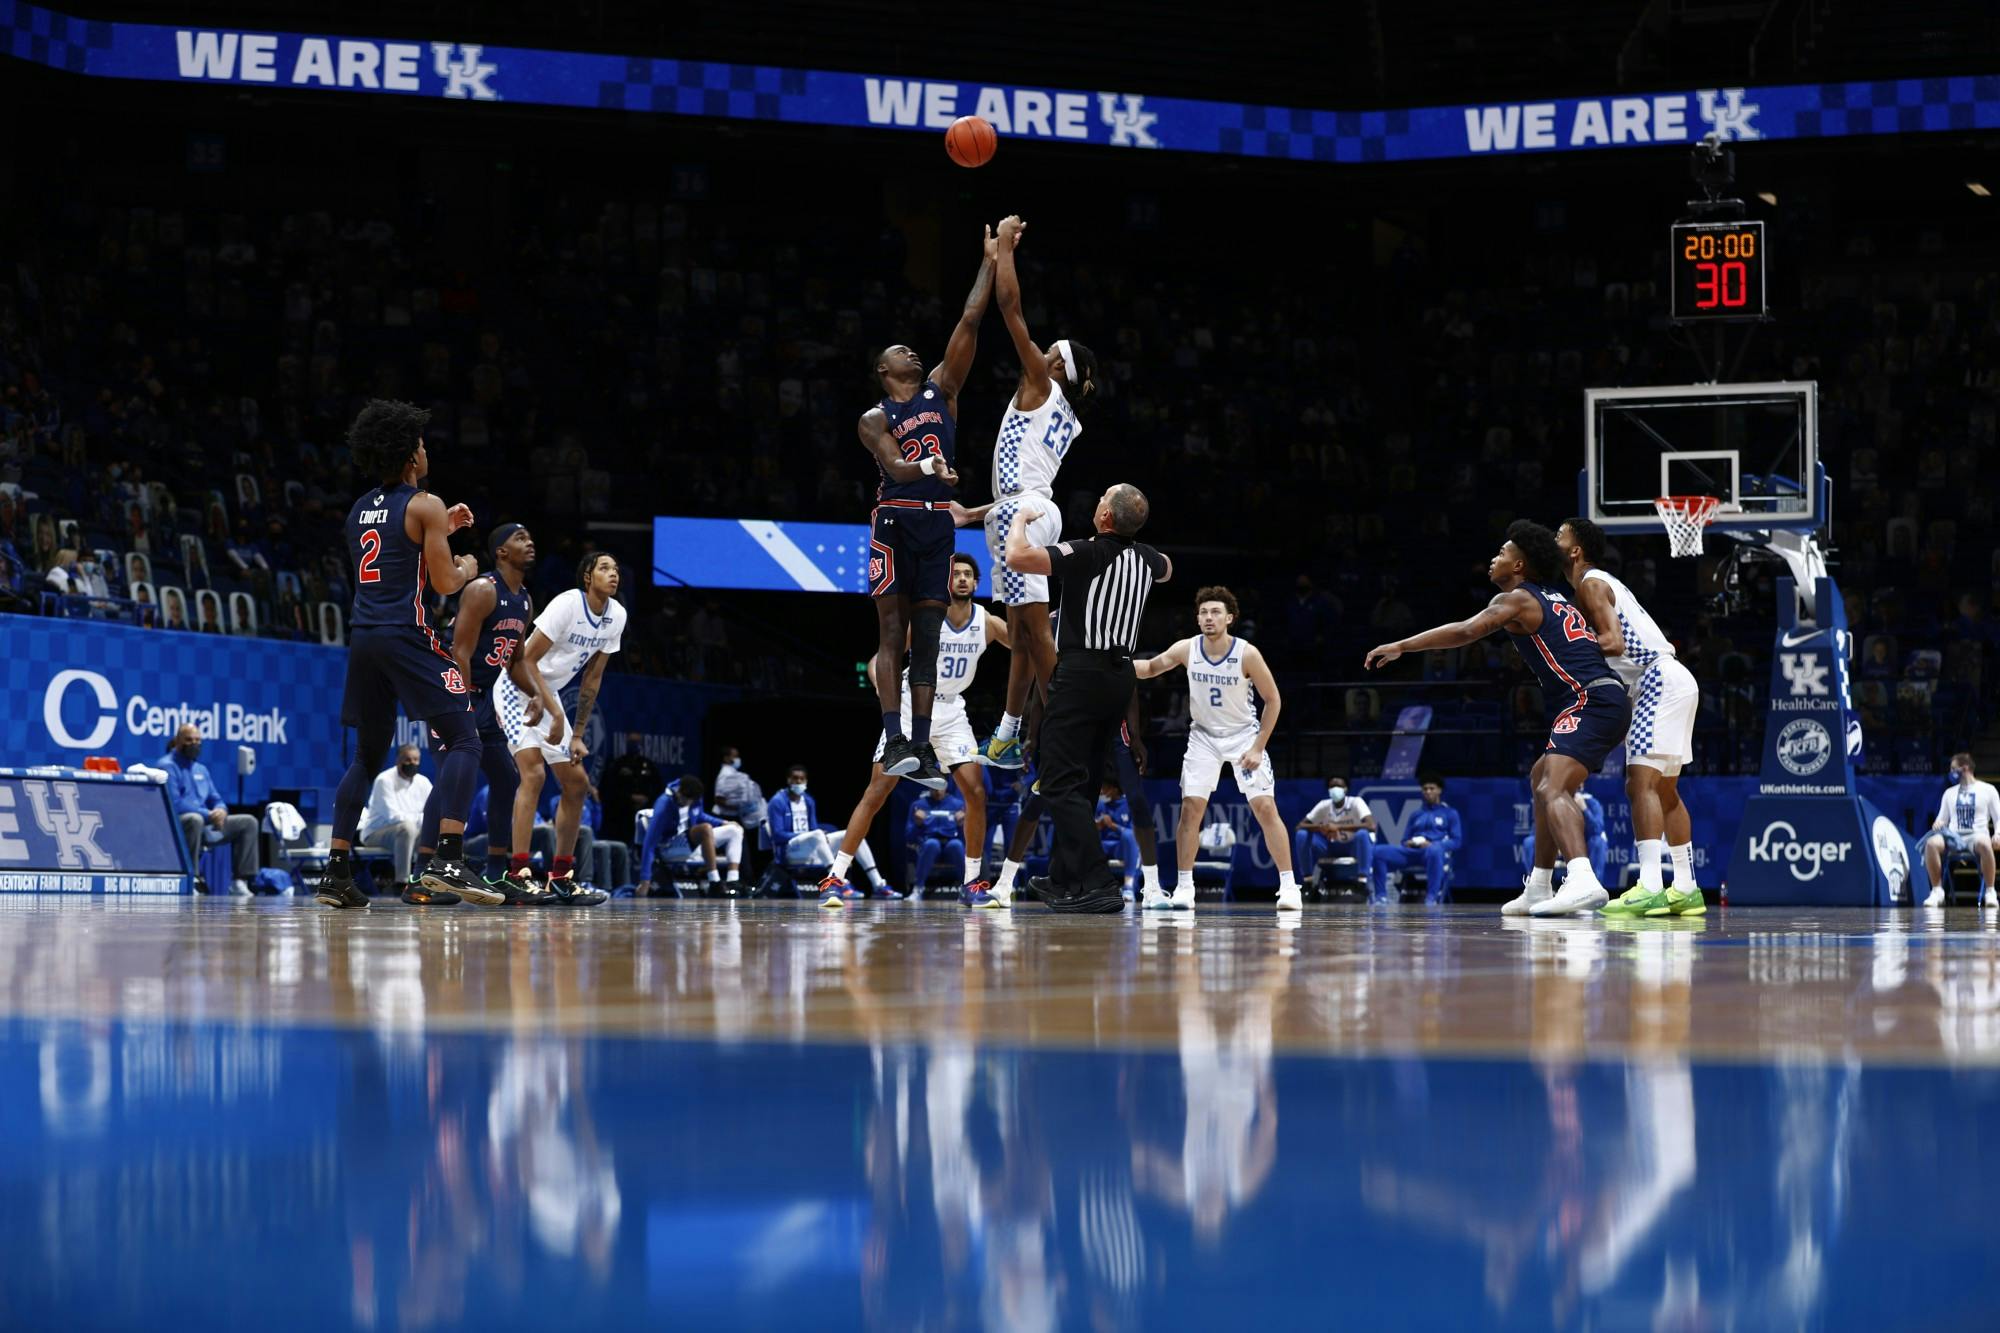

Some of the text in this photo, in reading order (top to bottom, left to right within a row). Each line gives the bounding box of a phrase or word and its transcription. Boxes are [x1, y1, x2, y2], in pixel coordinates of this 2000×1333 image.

[176, 30, 498, 101] WE ARE UK
[864, 78, 1159, 149] WE ARE UK
[1464, 87, 1760, 152] WE ARE UK
[1684, 233, 1755, 261] 20:00
[1695, 261, 1747, 309] 30
[892, 411, 944, 439] AUBURN
[1042, 411, 1074, 457] 23
[901, 433, 943, 462] 23
[359, 509, 389, 525] COOPER
[359, 529, 382, 584] 2
[485, 636, 519, 668] 35
[940, 643, 980, 654] ENTUCKY
[940, 656, 968, 679] 30
[1191, 671, 1239, 686] KENTUCKY
[1779, 652, 1830, 696] UK
[1209, 687, 1223, 707] 2
[1771, 698, 1840, 712] HealthCare
[126, 695, 288, 745] Central Bank
[1759, 783, 1846, 795] UKathletics.com
[22, 779, 115, 871] UK
[1749, 820, 1852, 882] Kroger
